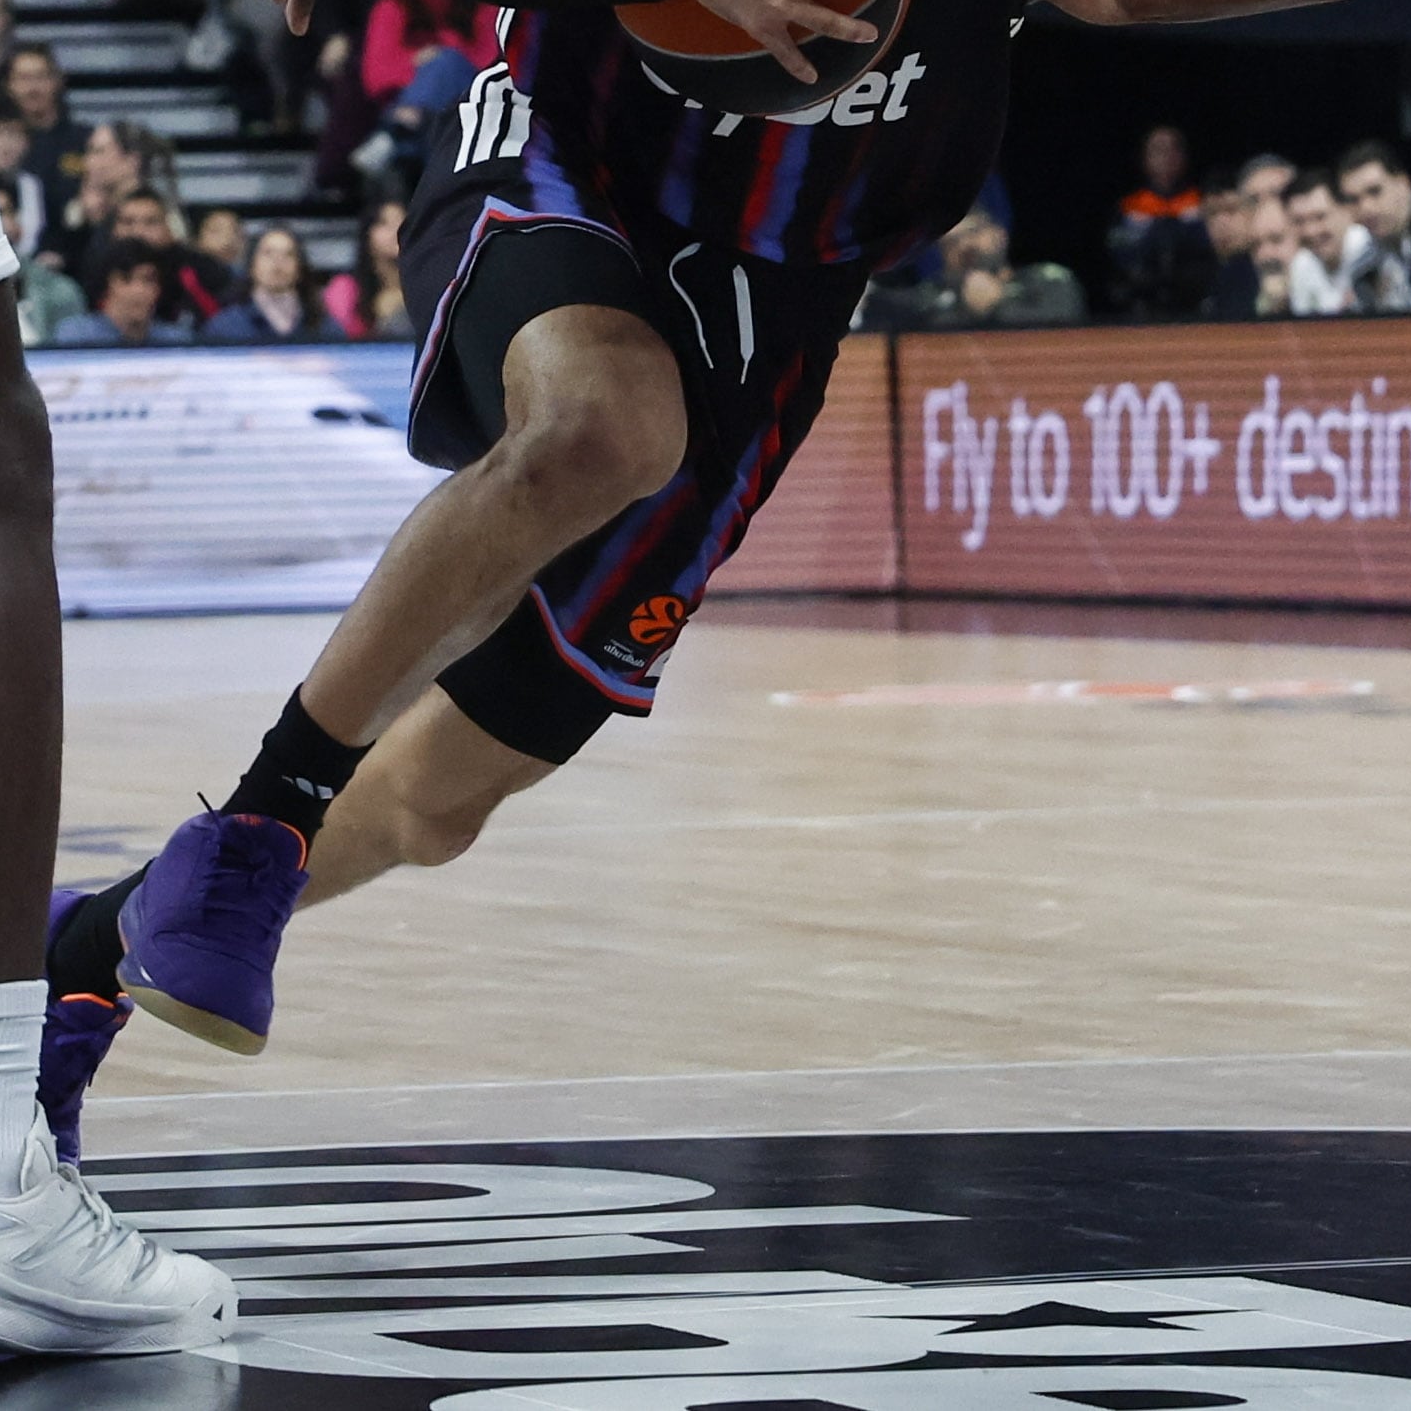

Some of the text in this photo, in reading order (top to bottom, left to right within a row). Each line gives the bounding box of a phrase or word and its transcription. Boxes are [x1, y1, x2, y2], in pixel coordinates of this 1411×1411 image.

[922, 379, 995, 551] Fly
[1008, 398, 1069, 519] to
[1083, 380, 1222, 520] 100+
